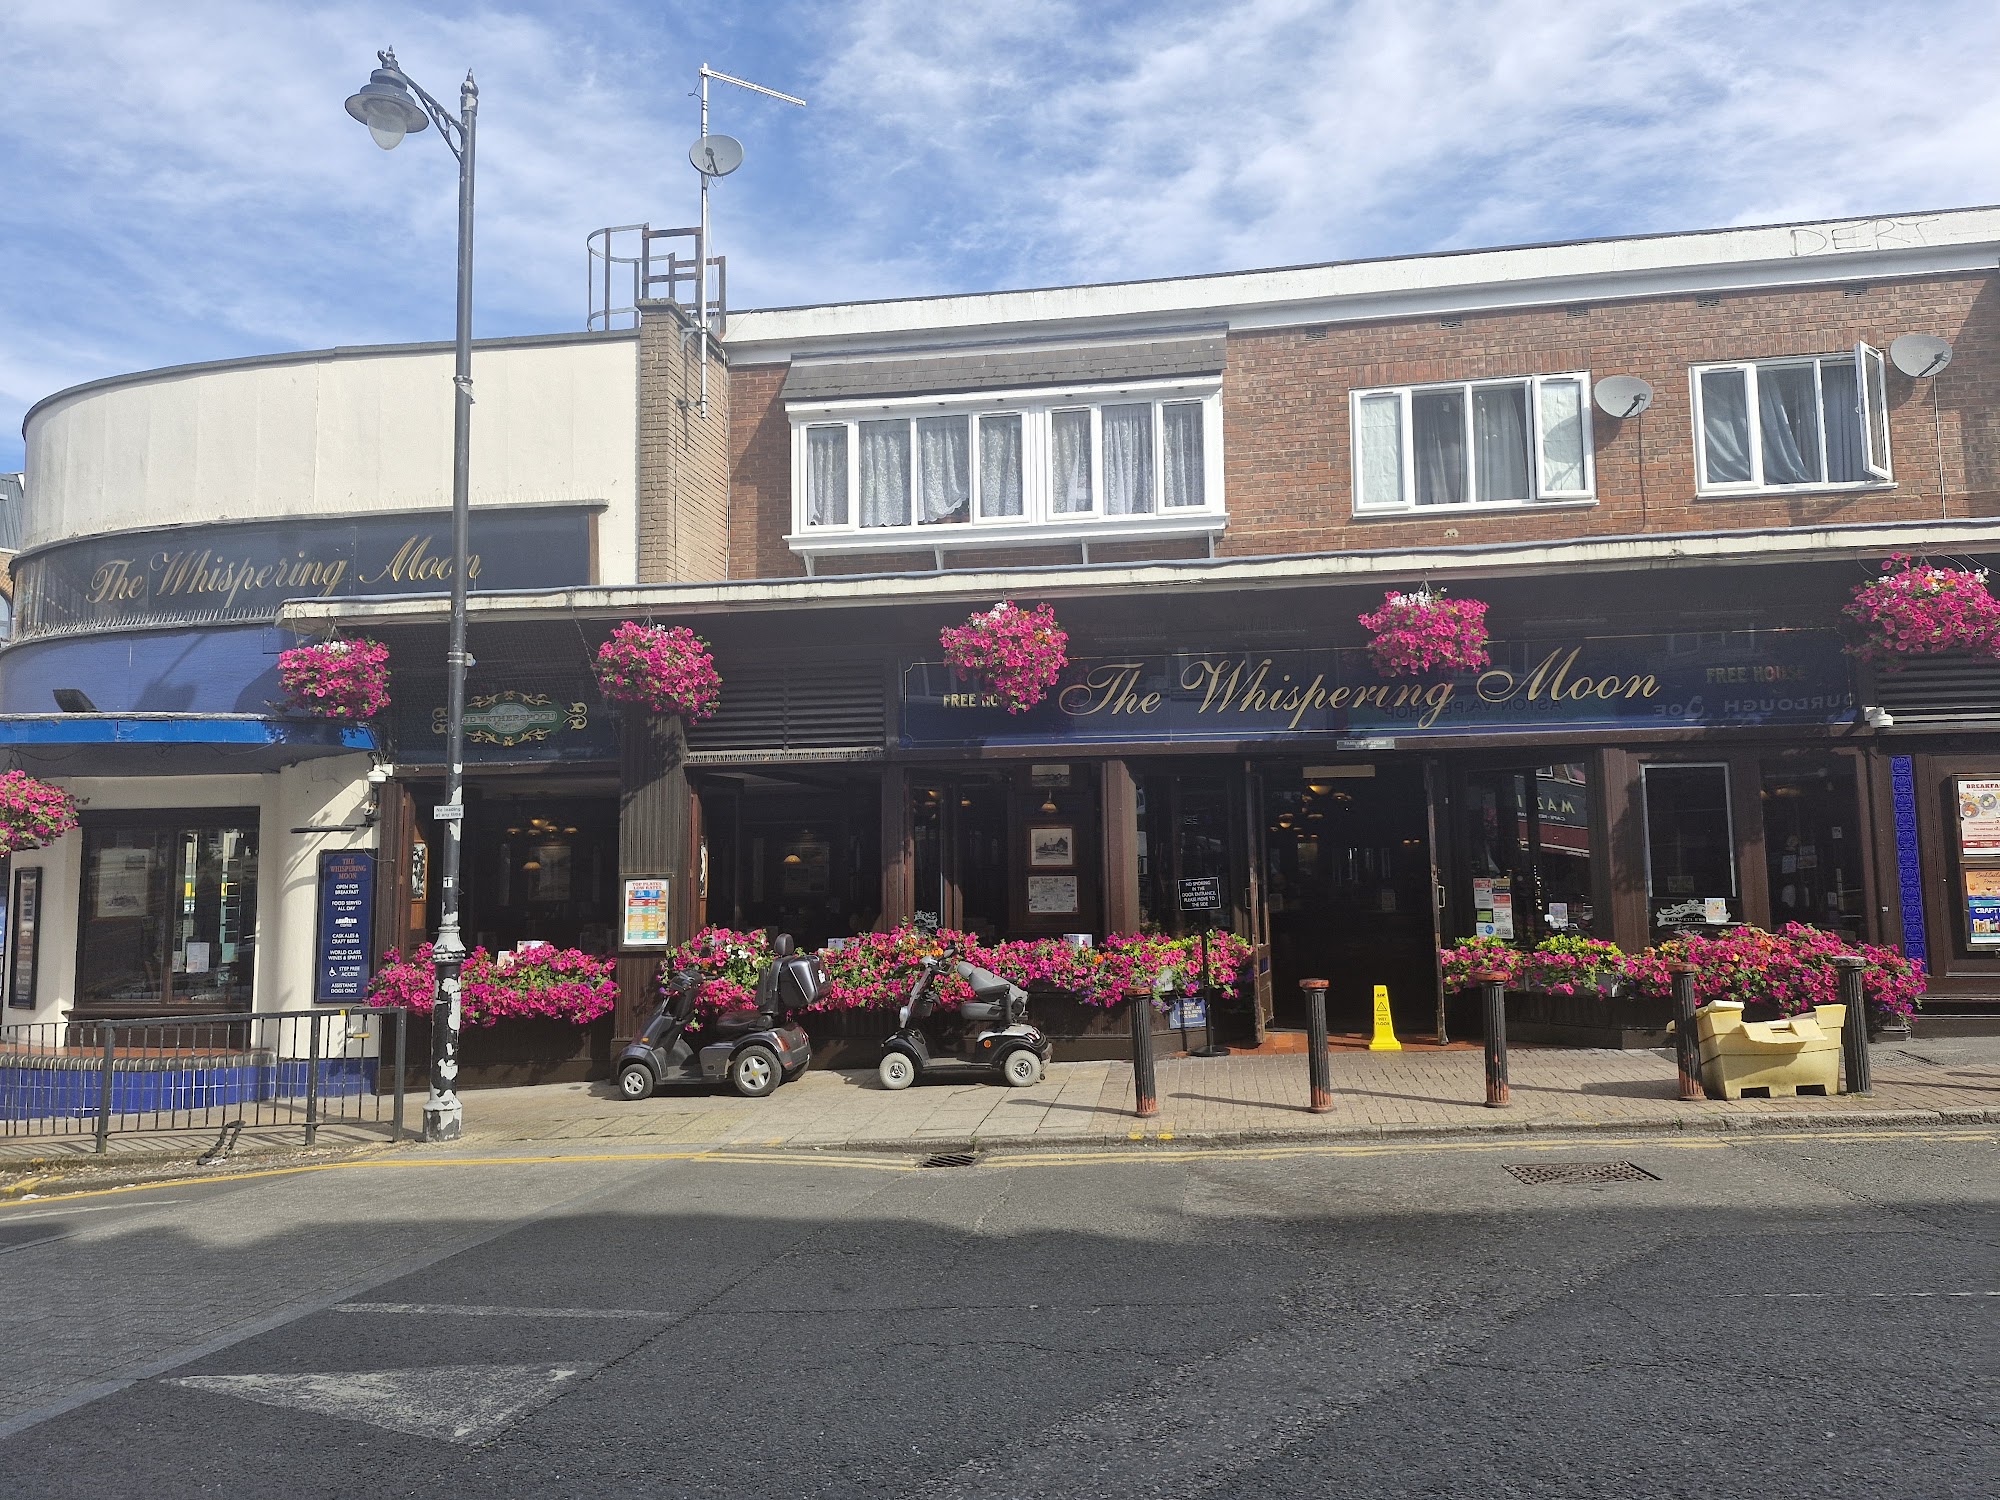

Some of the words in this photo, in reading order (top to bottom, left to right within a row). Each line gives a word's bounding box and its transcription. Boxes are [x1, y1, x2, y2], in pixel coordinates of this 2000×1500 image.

[1790, 219, 1940, 256] DERT
[86, 558, 145, 603] The
[150, 548, 349, 608] Whispering
[1058, 662, 1162, 716] The
[1181, 658, 1455, 729] Whispering
[1476, 646, 1661, 703] Moon
[1706, 667, 1747, 684] FREE
[1752, 665, 1806, 682] HOUSE
[943, 693, 977, 708] FREE
[479, 713, 555, 723] WETHERSPOON
